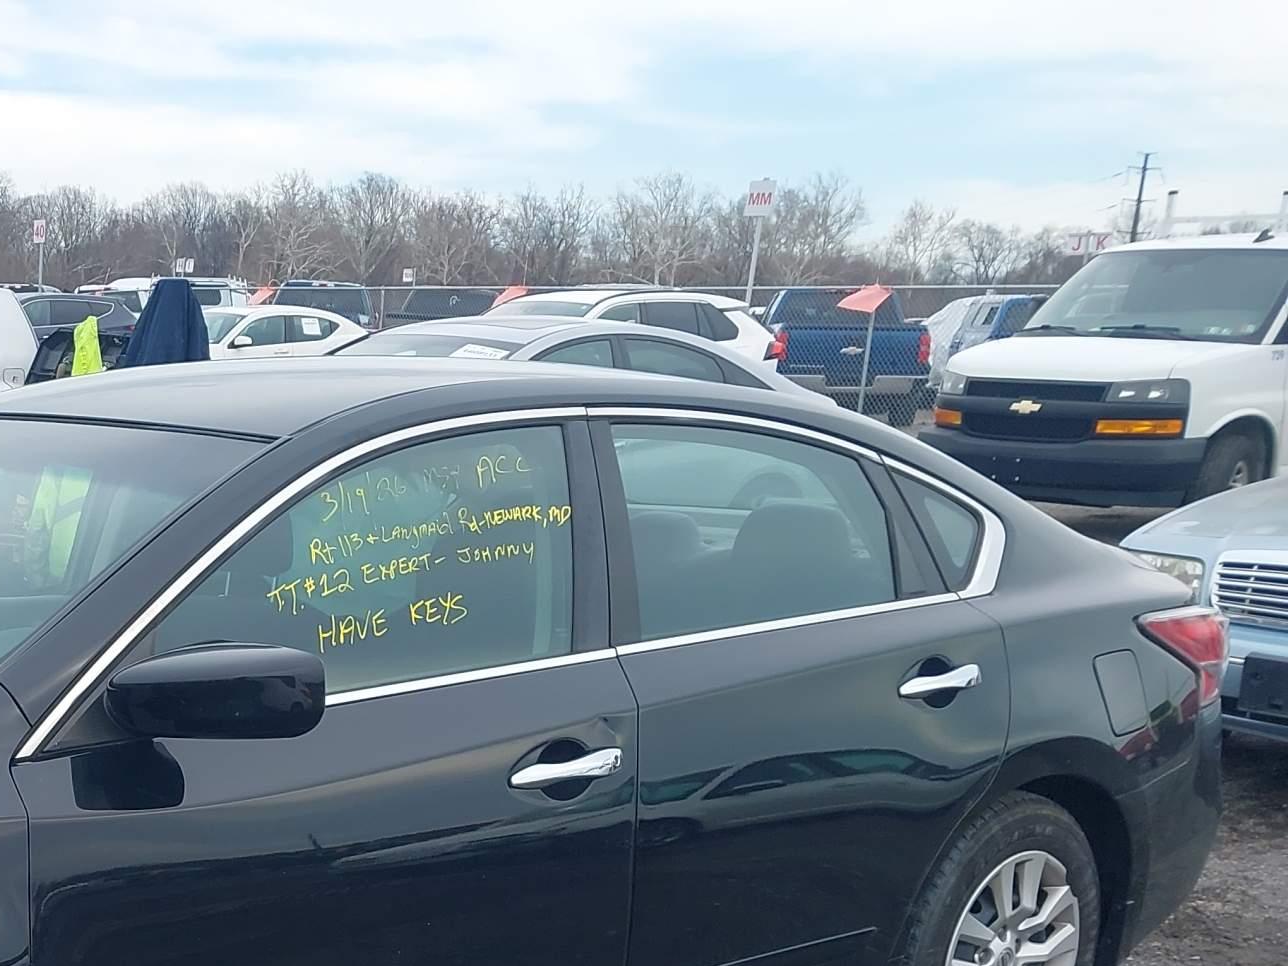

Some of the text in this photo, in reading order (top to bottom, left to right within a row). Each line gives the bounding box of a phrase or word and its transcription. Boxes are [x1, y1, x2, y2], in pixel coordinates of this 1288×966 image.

[748, 192, 772, 206] MM
[34, 224, 45, 239] 40
[1072, 235, 1109, 251] J K
[476, 455, 532, 489] ACC
[317, 592, 468, 653] HAVE KEYS
